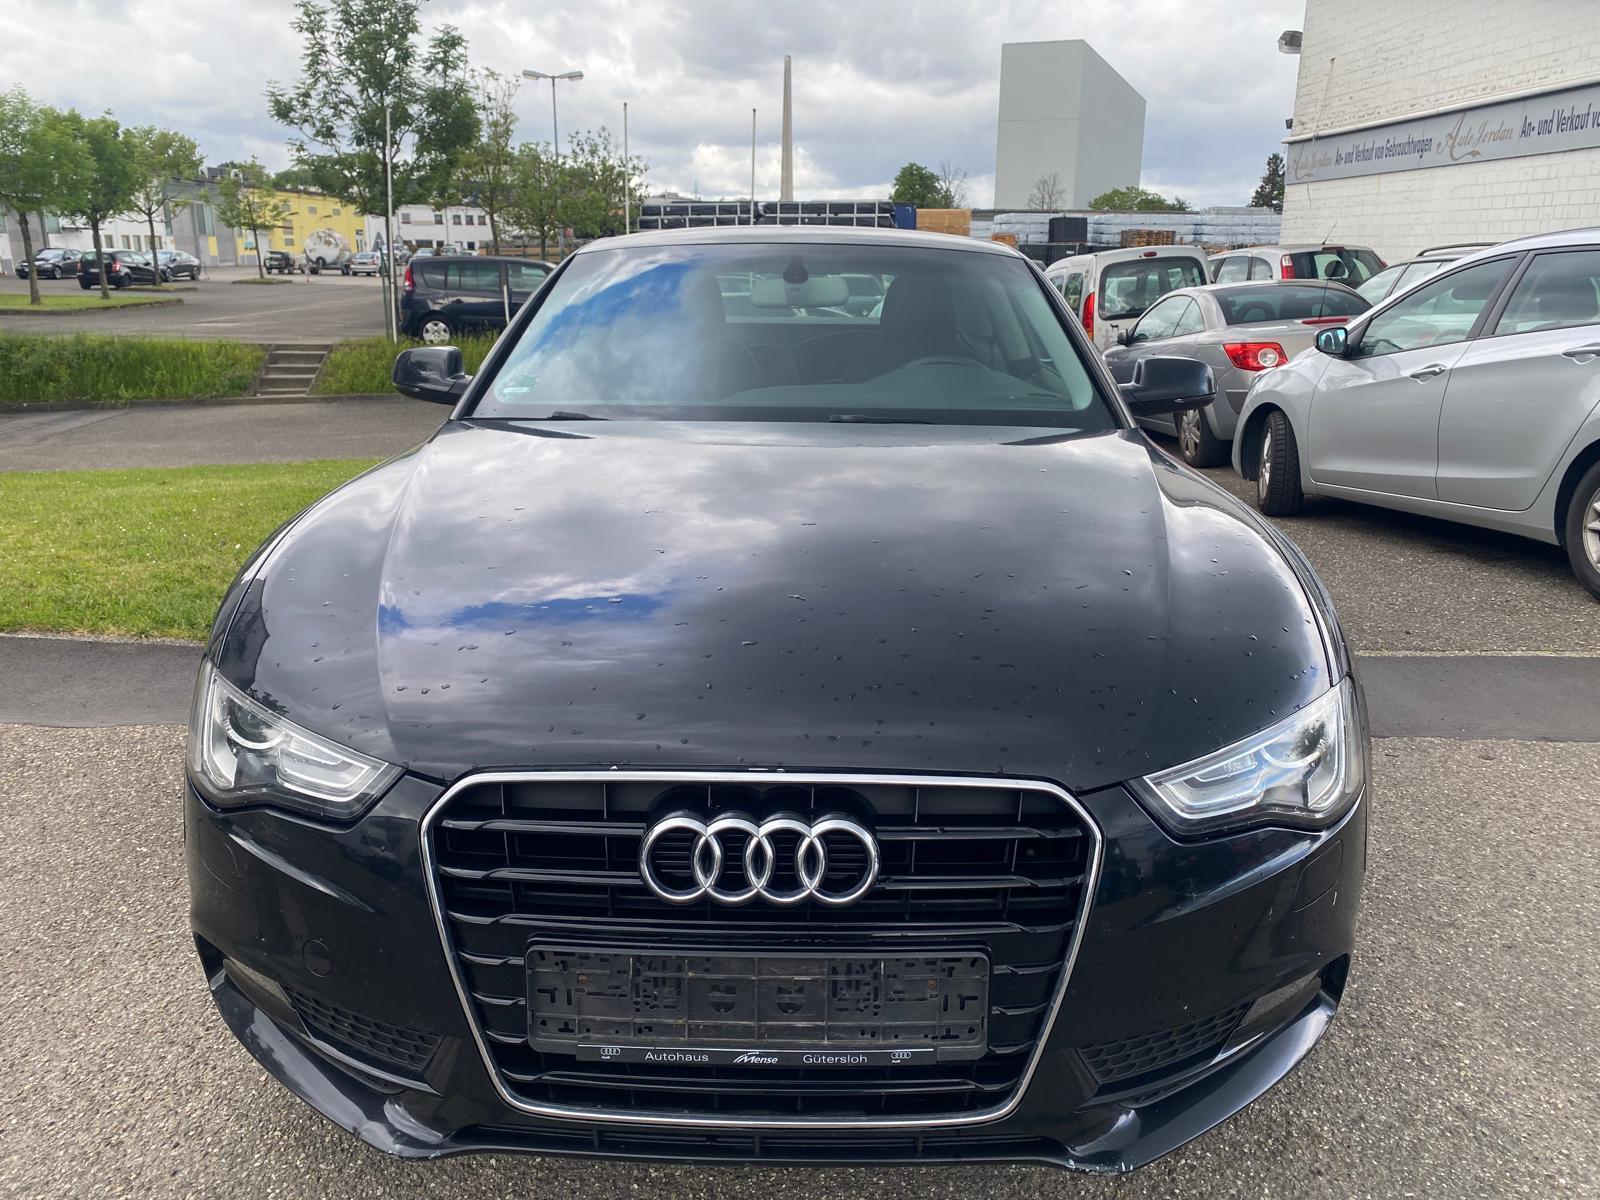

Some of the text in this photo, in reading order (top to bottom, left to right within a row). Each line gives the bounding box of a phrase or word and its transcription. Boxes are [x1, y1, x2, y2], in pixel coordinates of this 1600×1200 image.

[1475, 120, 1514, 147] Jordan
[1521, 115, 1536, 139] An-
[1537, 110, 1555, 136] und
[1556, 103, 1592, 133] Verkauf
[1344, 144, 1355, 164] und
[1355, 140, 1375, 163] Verkauf
[1375, 145, 1384, 160] von
[1384, 133, 1432, 158] Gebrauchtwagen
[644, 1051, 868, 1064] Autohaus Mense Gütersloh
